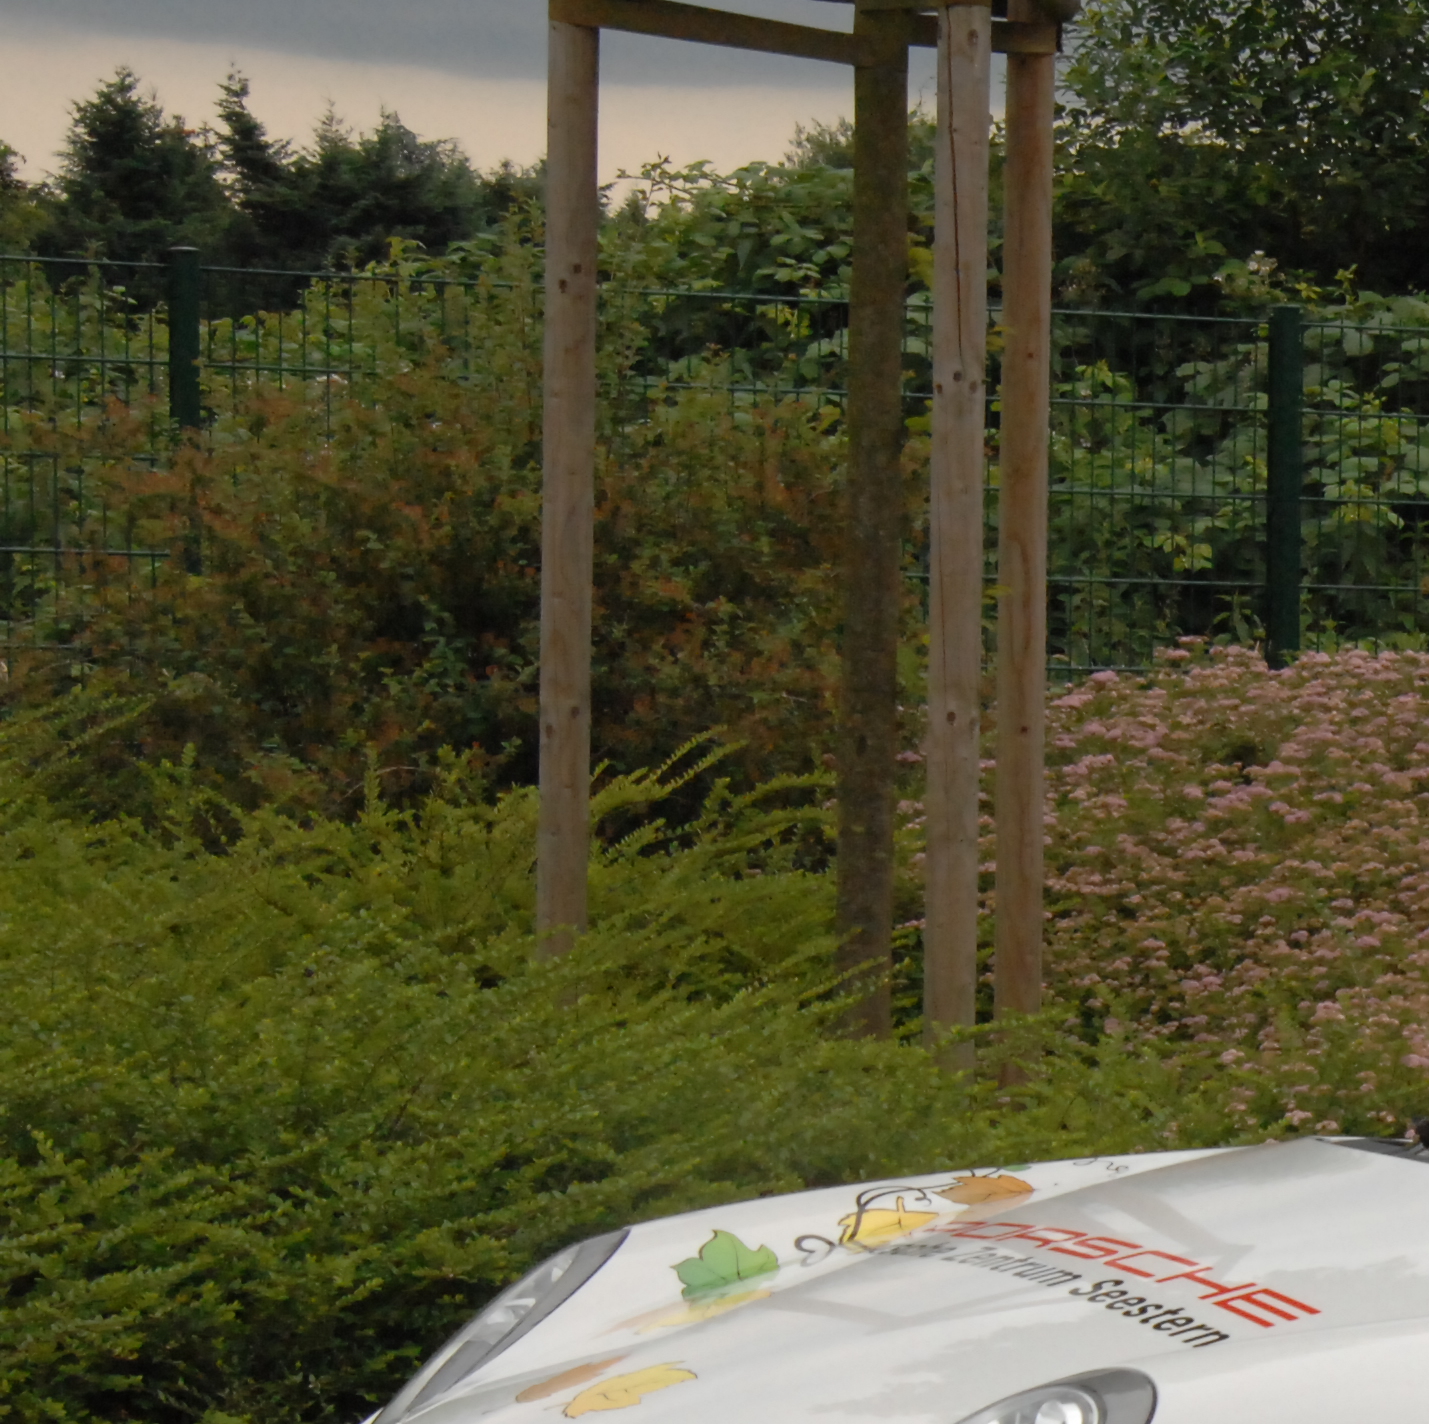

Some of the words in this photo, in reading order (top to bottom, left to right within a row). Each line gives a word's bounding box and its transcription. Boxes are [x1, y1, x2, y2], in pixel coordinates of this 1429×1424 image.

[923, 1220, 1322, 1328] PORSCHE
[940, 1245, 1083, 1288] Zentrum
[1068, 1278, 1231, 1348] Seestern
